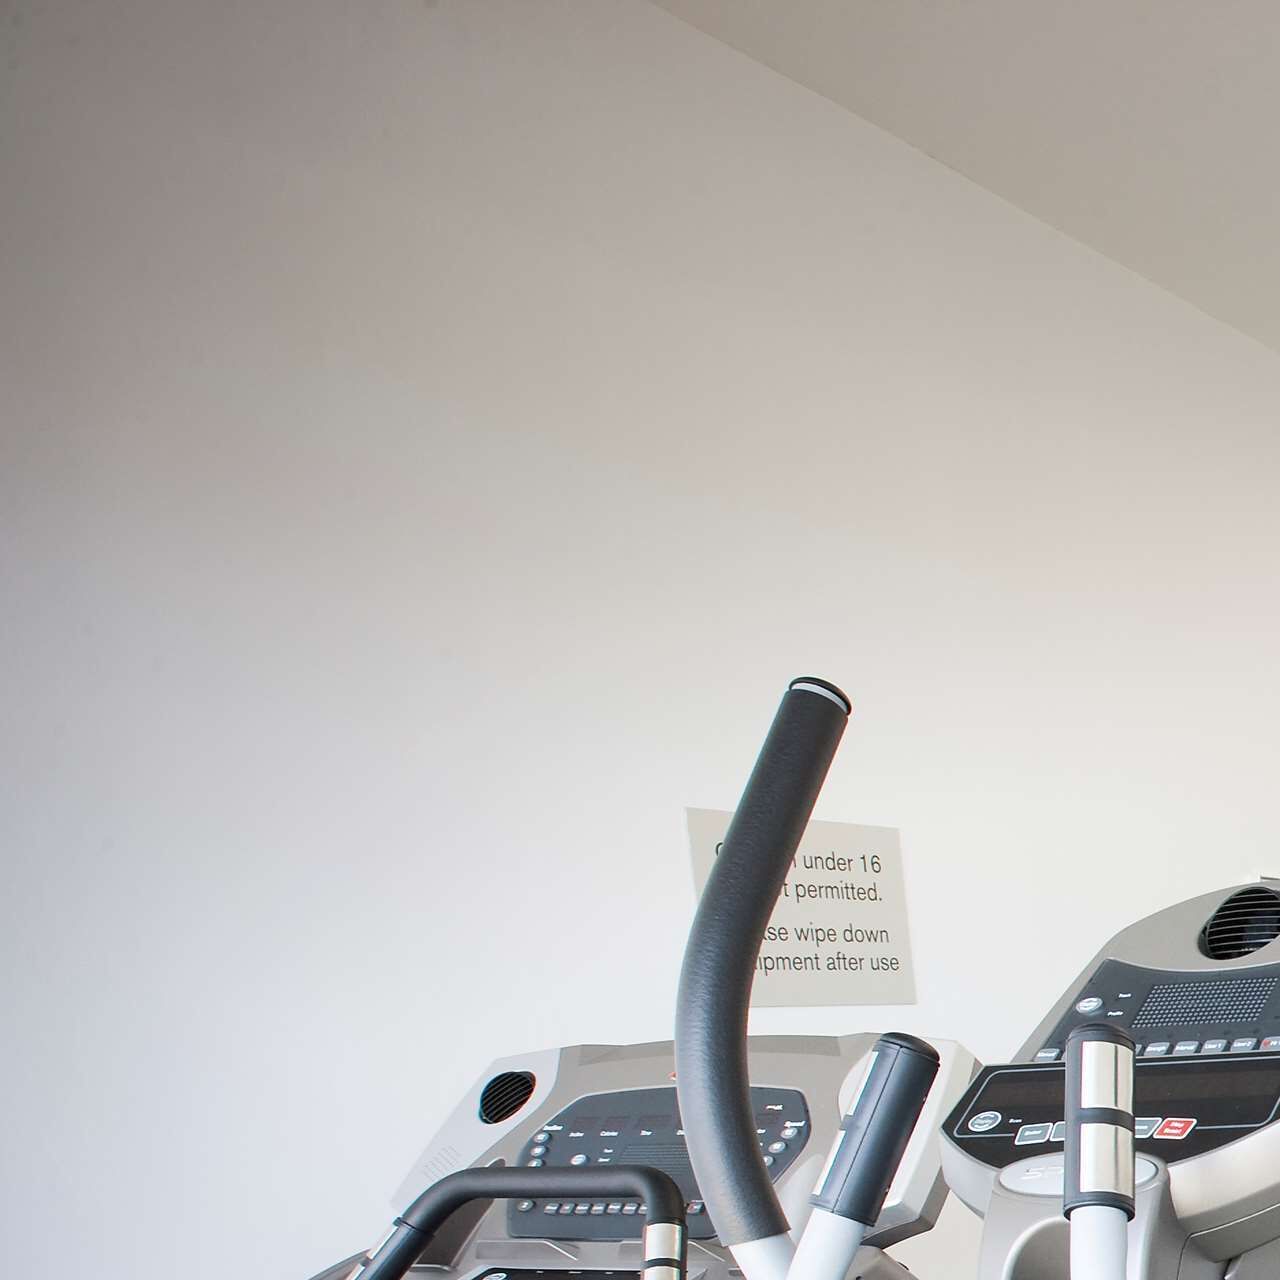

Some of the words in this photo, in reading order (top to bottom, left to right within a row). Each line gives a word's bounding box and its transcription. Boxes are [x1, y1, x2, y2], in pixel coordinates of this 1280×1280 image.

[803, 851, 853, 872] under
[860, 855, 882, 873] 16
[795, 880, 883, 903] permitted.
[794, 921, 837, 947] wipe
[843, 923, 890, 944] down
[756, 955, 821, 976] ipment
[826, 951, 865, 971] after
[870, 956, 900, 971] use
